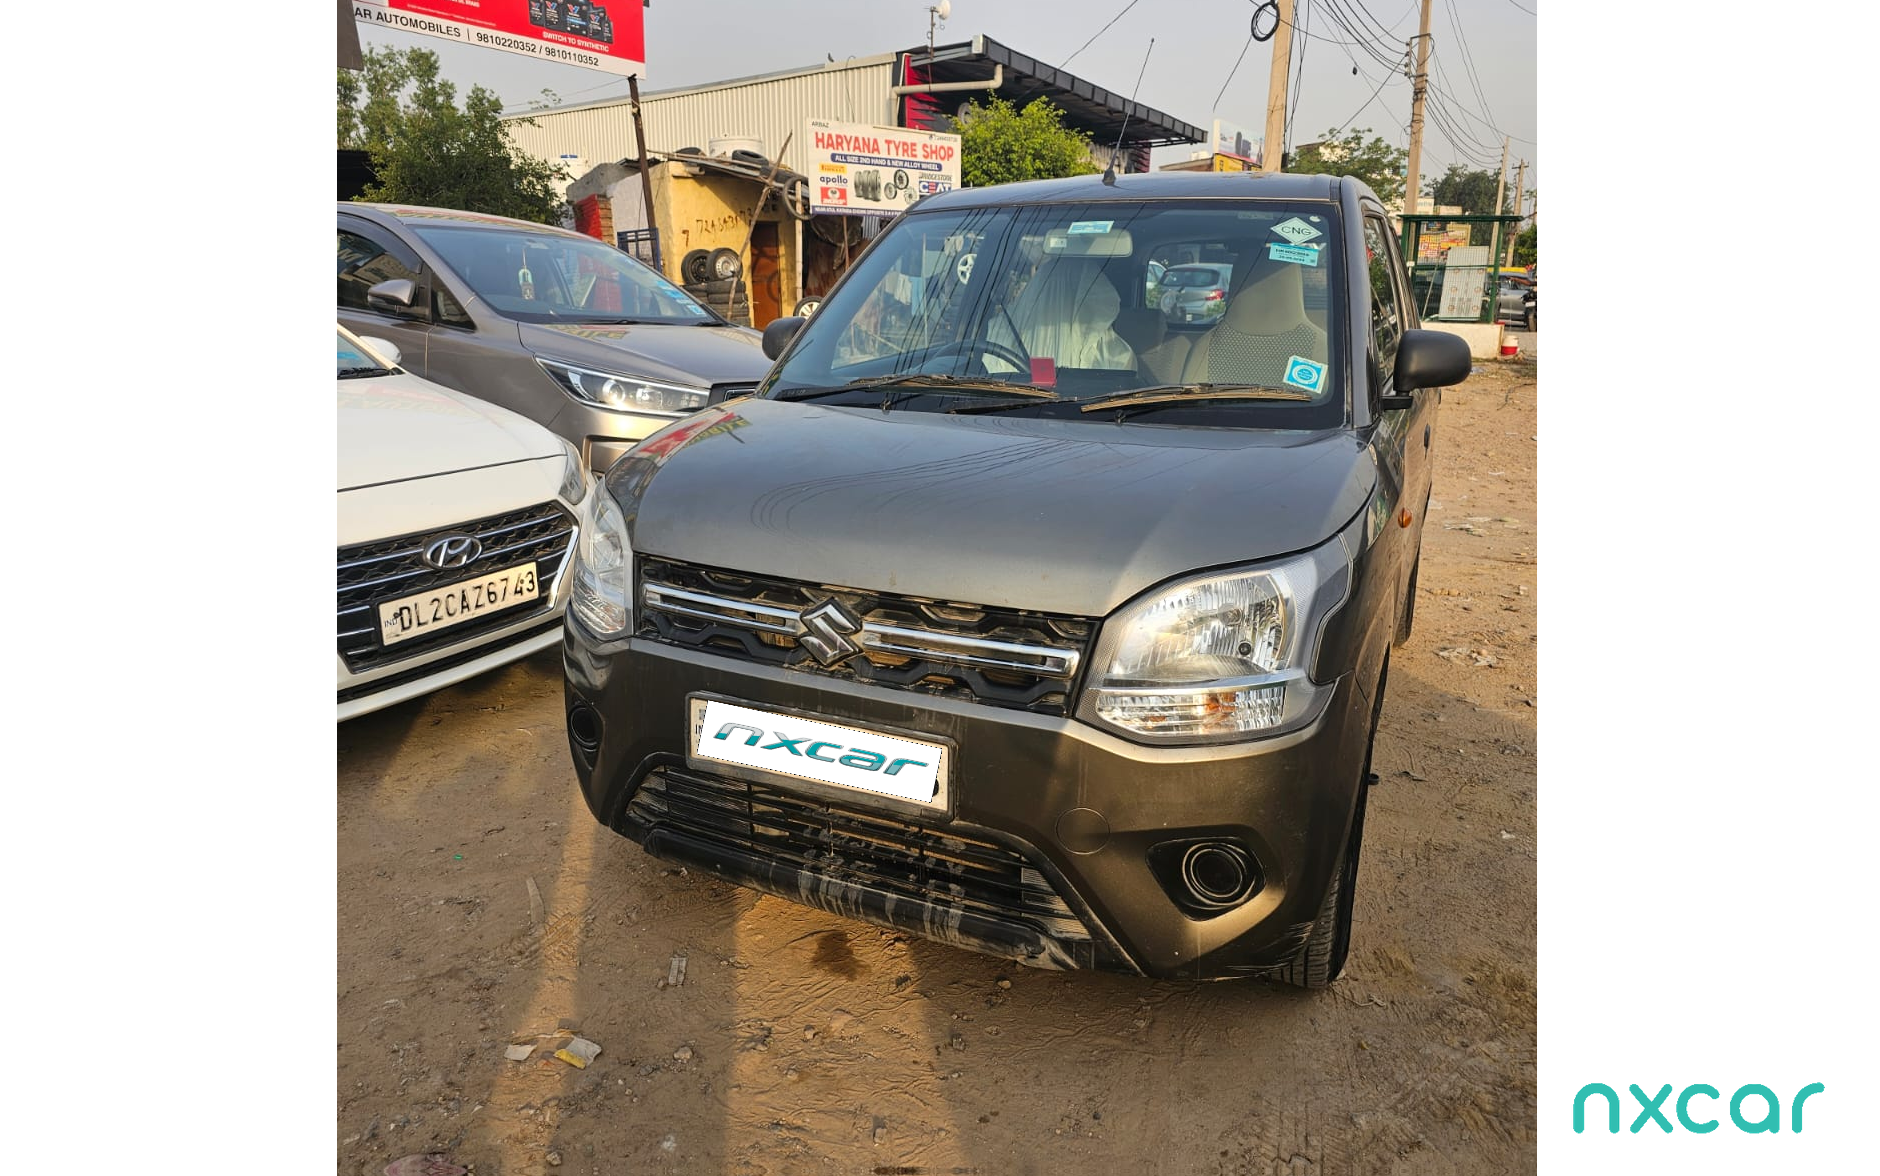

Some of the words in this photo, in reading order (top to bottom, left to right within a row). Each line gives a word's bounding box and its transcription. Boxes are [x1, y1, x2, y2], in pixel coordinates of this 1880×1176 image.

[376, 10, 461, 37] AUTOMOBILES
[476, 32, 537, 53] 9810220352
[544, 47, 600, 66] 9810110352
[815, 131, 881, 154] HARYANA
[884, 139, 918, 158] TYRE
[922, 143, 954, 161] SHOP
[835, 154, 846, 162] ALL
[904, 161, 920, 169] ALLOY
[819, 175, 848, 185] apollo
[919, 181, 951, 194] CEAT
[1281, 226, 1312, 236] CNG
[399, 571, 536, 633] DL2CAZ6743
